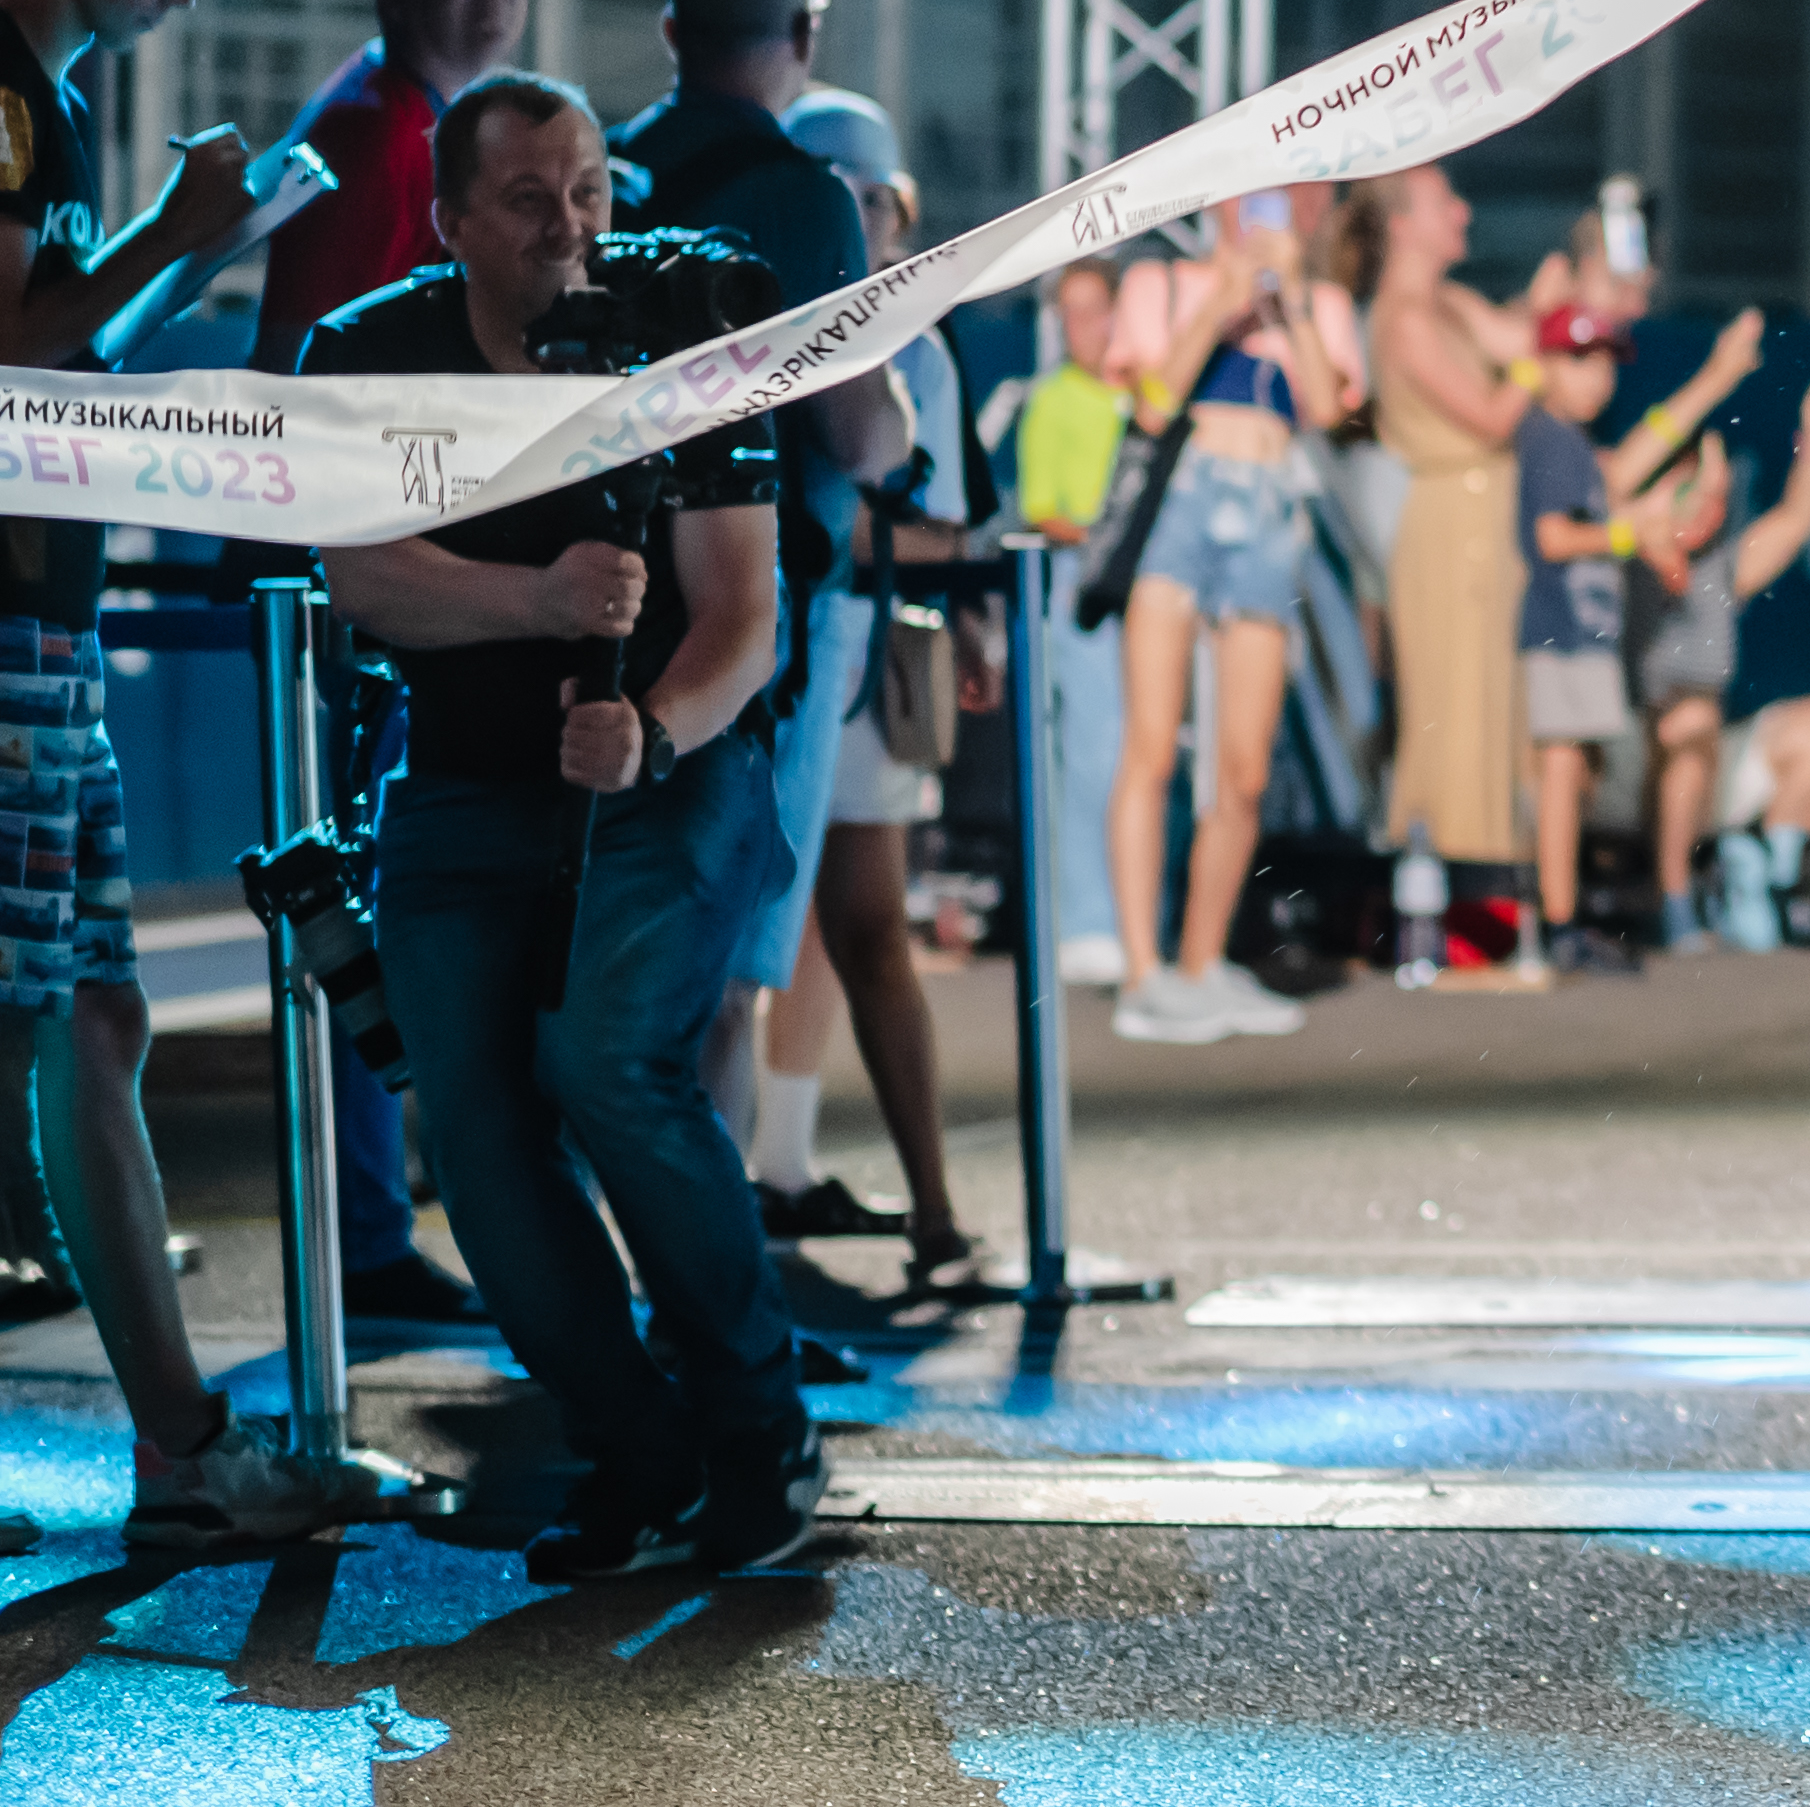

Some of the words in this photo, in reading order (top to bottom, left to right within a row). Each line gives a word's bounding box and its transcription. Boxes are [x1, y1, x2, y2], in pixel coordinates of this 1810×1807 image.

[1271, 42, 1421, 144] НОЧНОЙ
[1289, 28, 1505, 178] ЗАБЕГ
[25, 398, 285, 440] МУЗЫКАЛЬНЫЙ
[128, 443, 296, 506] 2023
